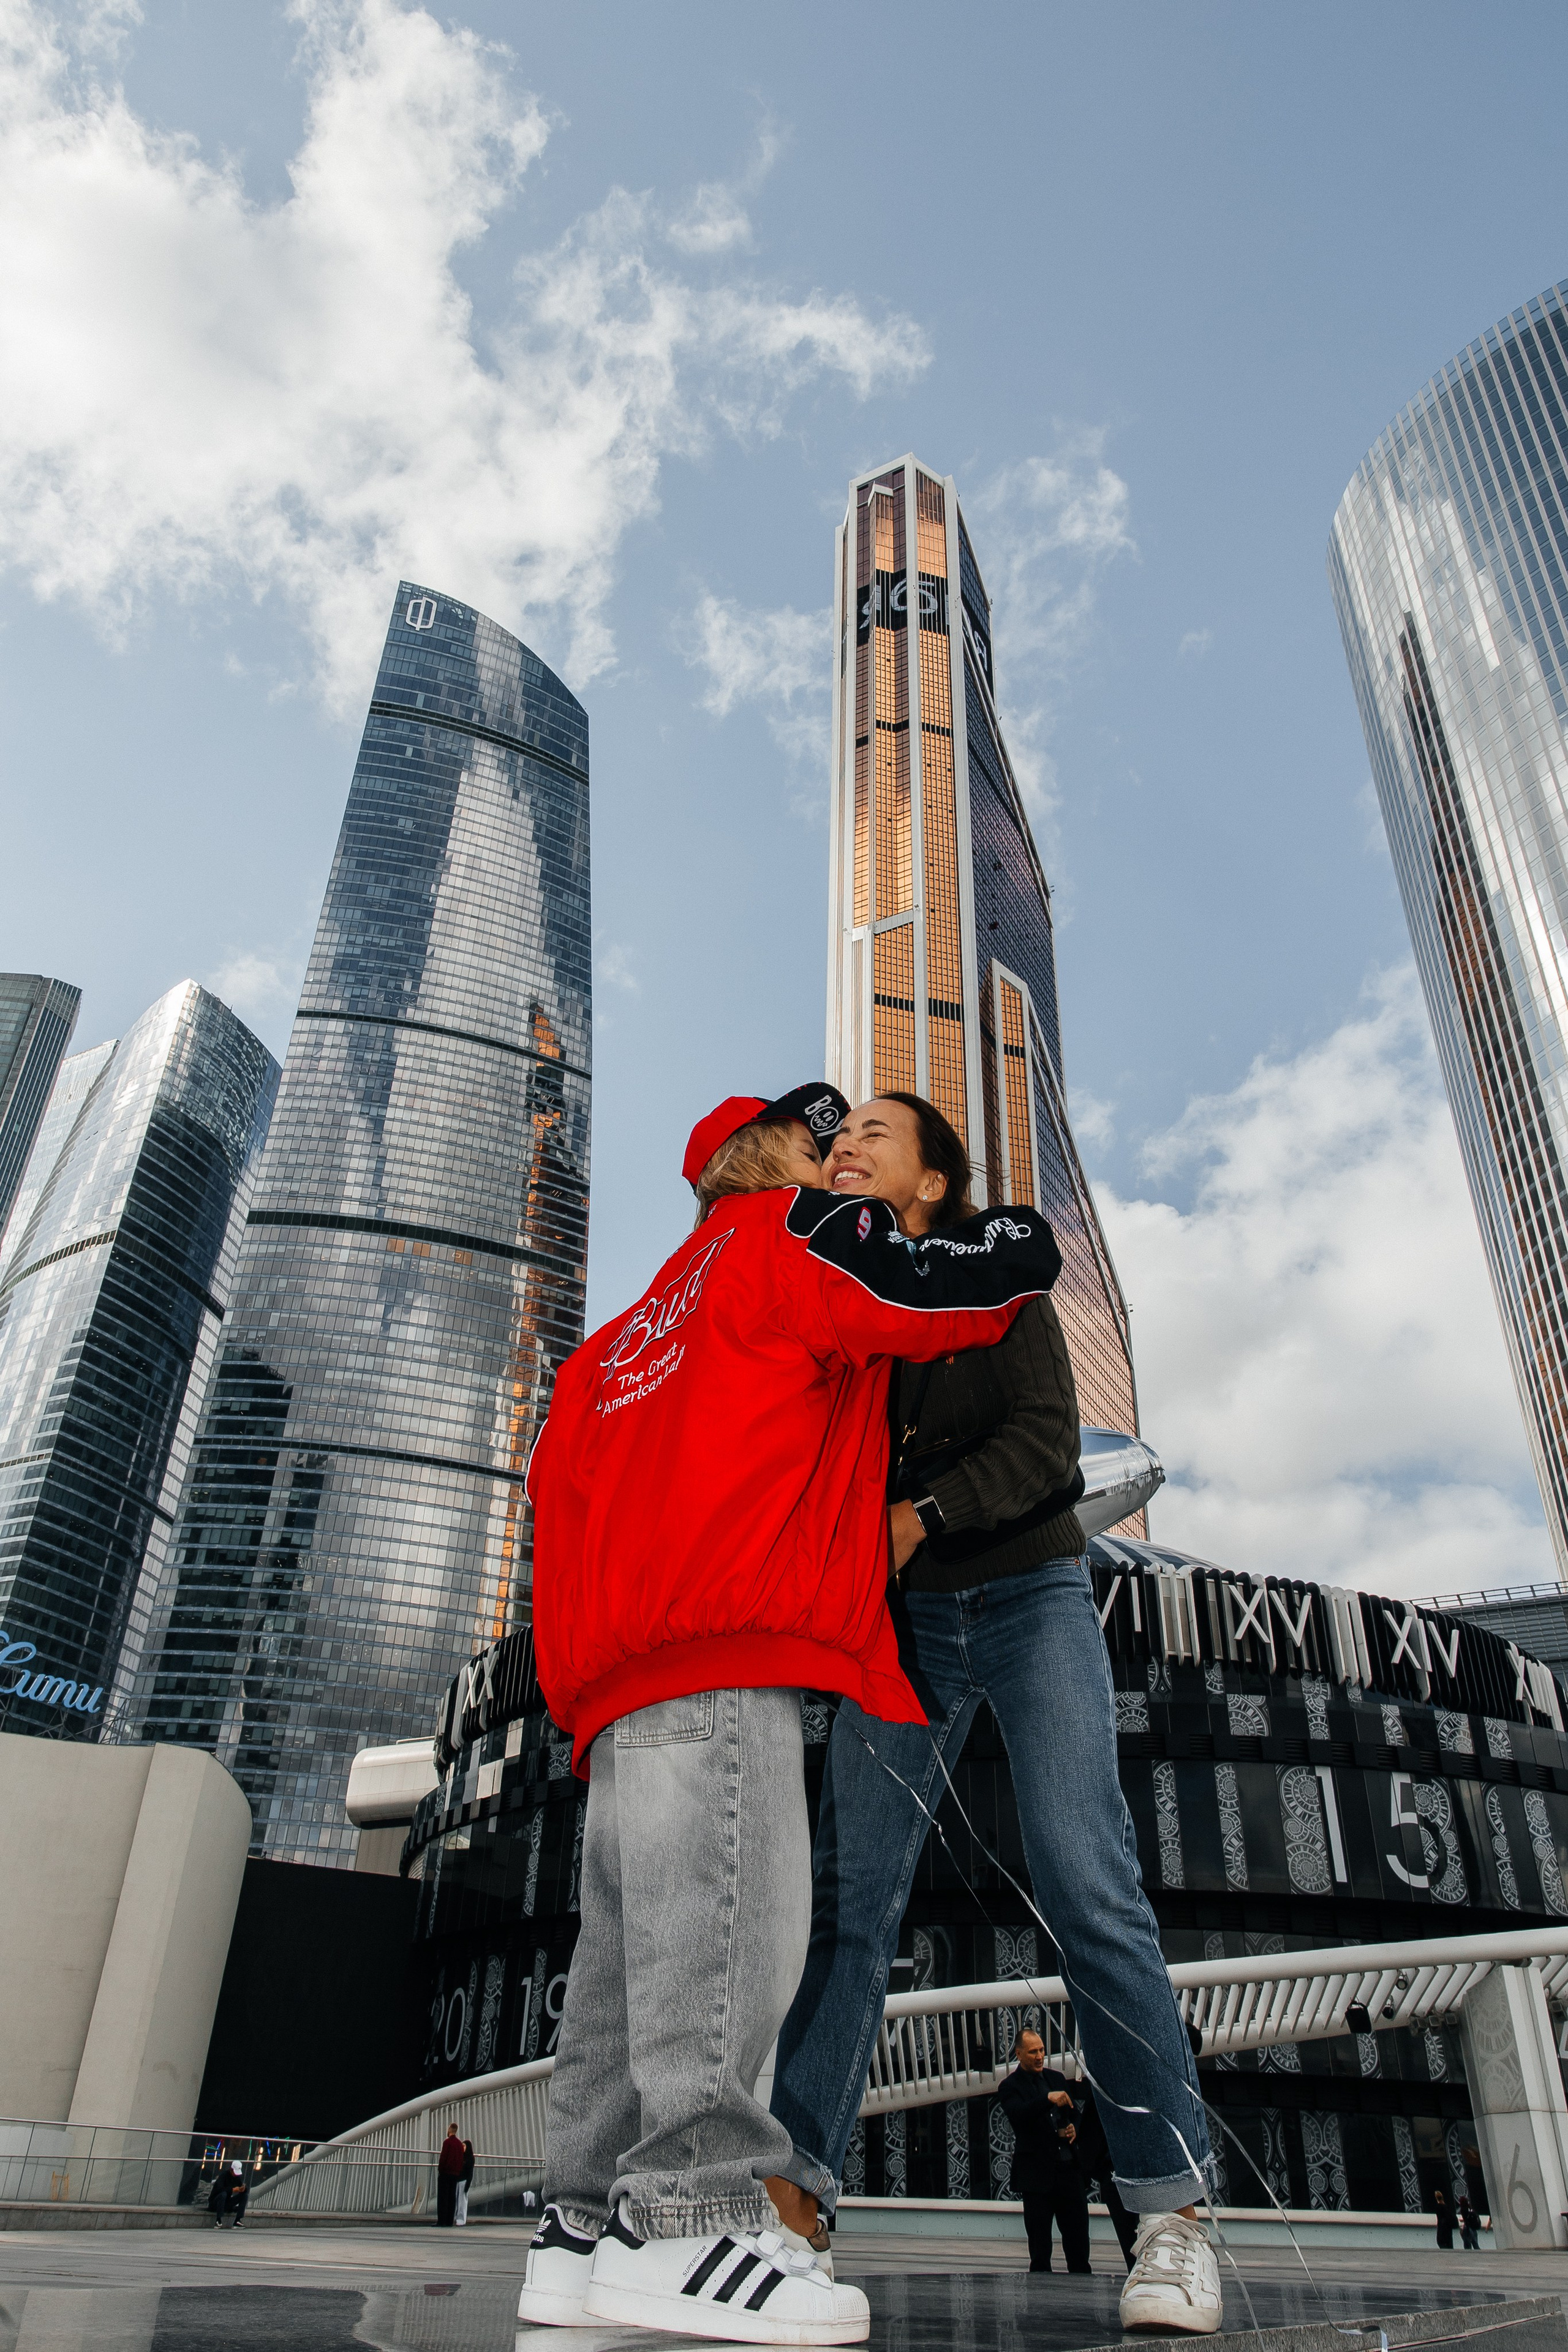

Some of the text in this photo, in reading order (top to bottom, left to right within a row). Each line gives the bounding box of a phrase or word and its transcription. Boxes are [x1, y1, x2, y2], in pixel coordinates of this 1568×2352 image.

[919, 1218, 1031, 1256] Budweiser
[600, 1242, 718, 1367] Bud
[618, 1342, 677, 1390] The Great
[602, 1375, 663, 1418] American
[1315, 1766, 1447, 1888] 15
[1507, 2143, 1537, 2233] 6
[682, 2245, 707, 2277] SUPERSTAR
